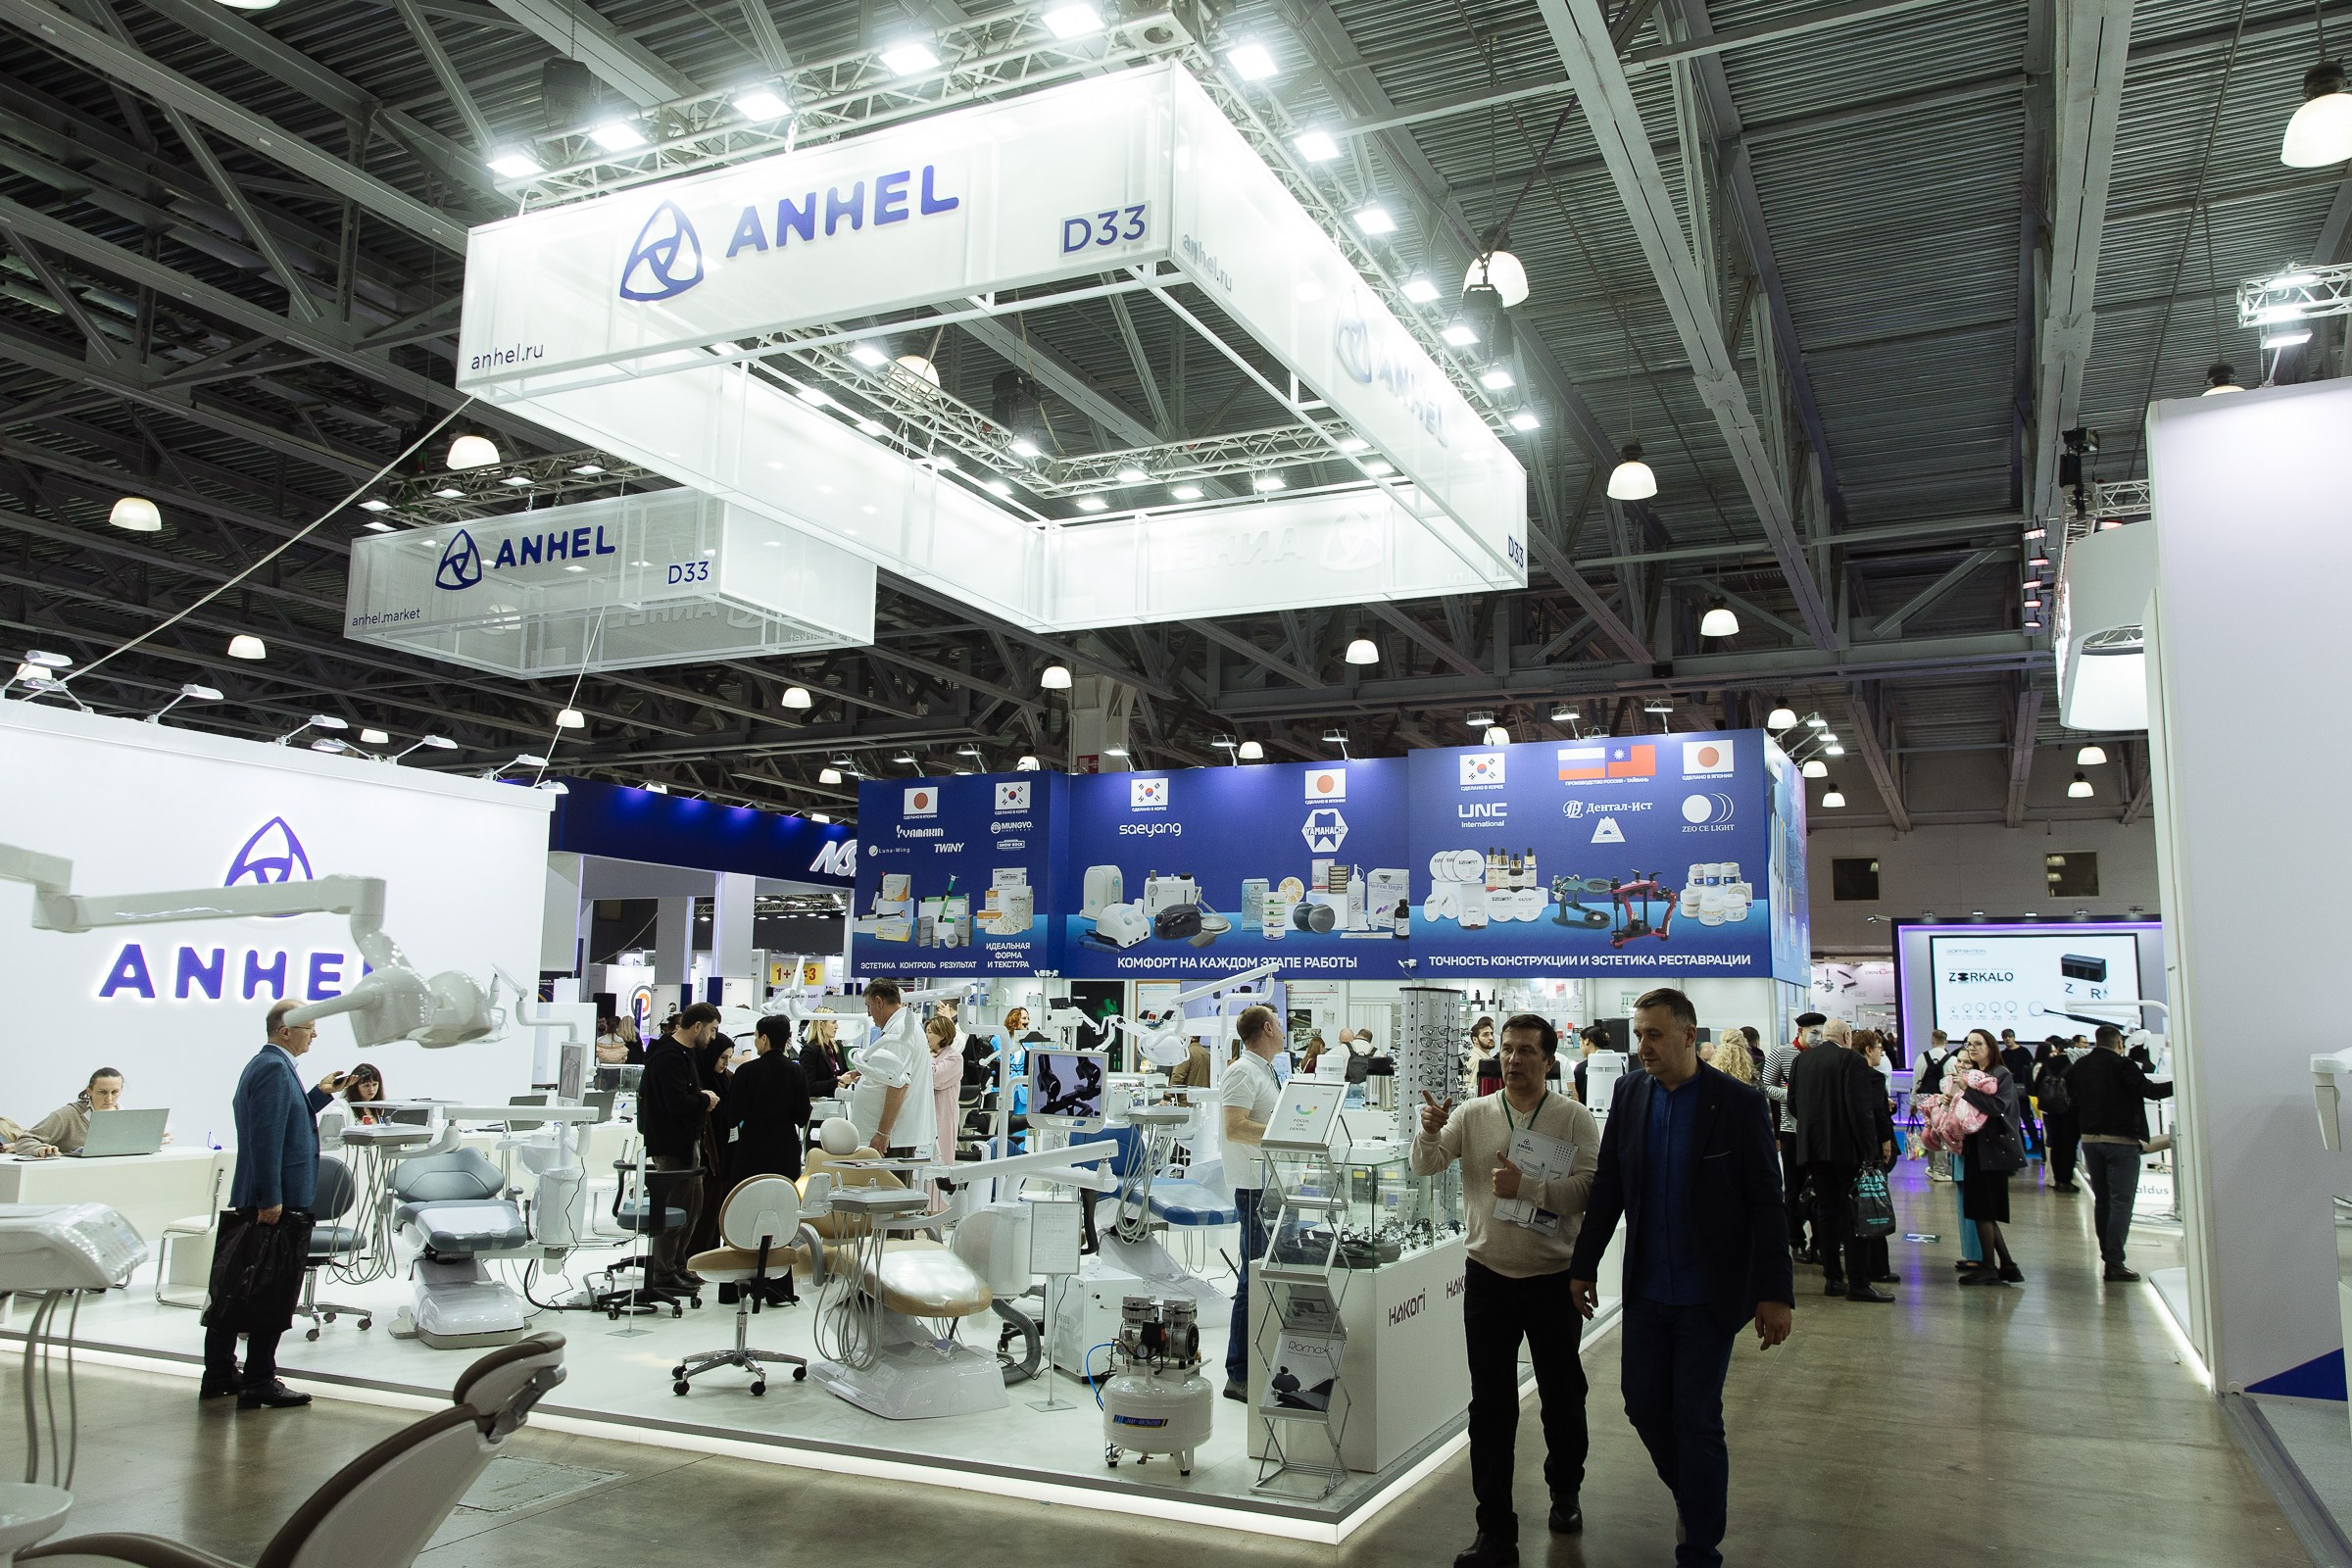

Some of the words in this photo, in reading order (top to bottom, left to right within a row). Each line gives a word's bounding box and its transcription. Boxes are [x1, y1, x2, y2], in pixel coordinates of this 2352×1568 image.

[726, 165, 959, 258] ANHEL
[1063, 204, 1147, 254] D33
[1183, 231, 1232, 292] anhel.ru
[470, 340, 544, 370] anhel.ru
[493, 524, 616, 569] ANHEL
[1507, 533, 1524, 568] D33
[667, 561, 710, 587] D33
[353, 608, 420, 626] anhel.market
[1458, 803, 1508, 818] UNC
[1586, 802, 1653, 814] Дентал-Ист
[1119, 822, 1182, 837] saeyang
[1304, 826, 1346, 836] YAMAHACHI
[809, 839, 858, 877] NS
[986, 942, 1031, 951] ИДЕАЛЬНАЯ
[995, 951, 1023, 959] ФОРМА
[1117, 956, 1178, 969] КОМФОРТ
[1179, 957, 1198, 968] НА
[1200, 956, 1258, 971] КАЖДОМ
[1303, 956, 1357, 968] РАБОТЫ
[1428, 956, 1490, 966] ТОЧНОСТЬ
[1491, 956, 1578, 967] КОНСТРУКЦИИ
[1580, 956, 1589, 966] И
[1591, 955, 1657, 966] ЭСТЕТИКА
[1658, 955, 1751, 967] РЕСТАВРАЦИИ
[99, 944, 376, 1001] ANHE
[1516, 1143, 1535, 1152] ANHEL
[2135, 1185, 2169, 1195] aldus
[1446, 1275, 1465, 1299] HAK
